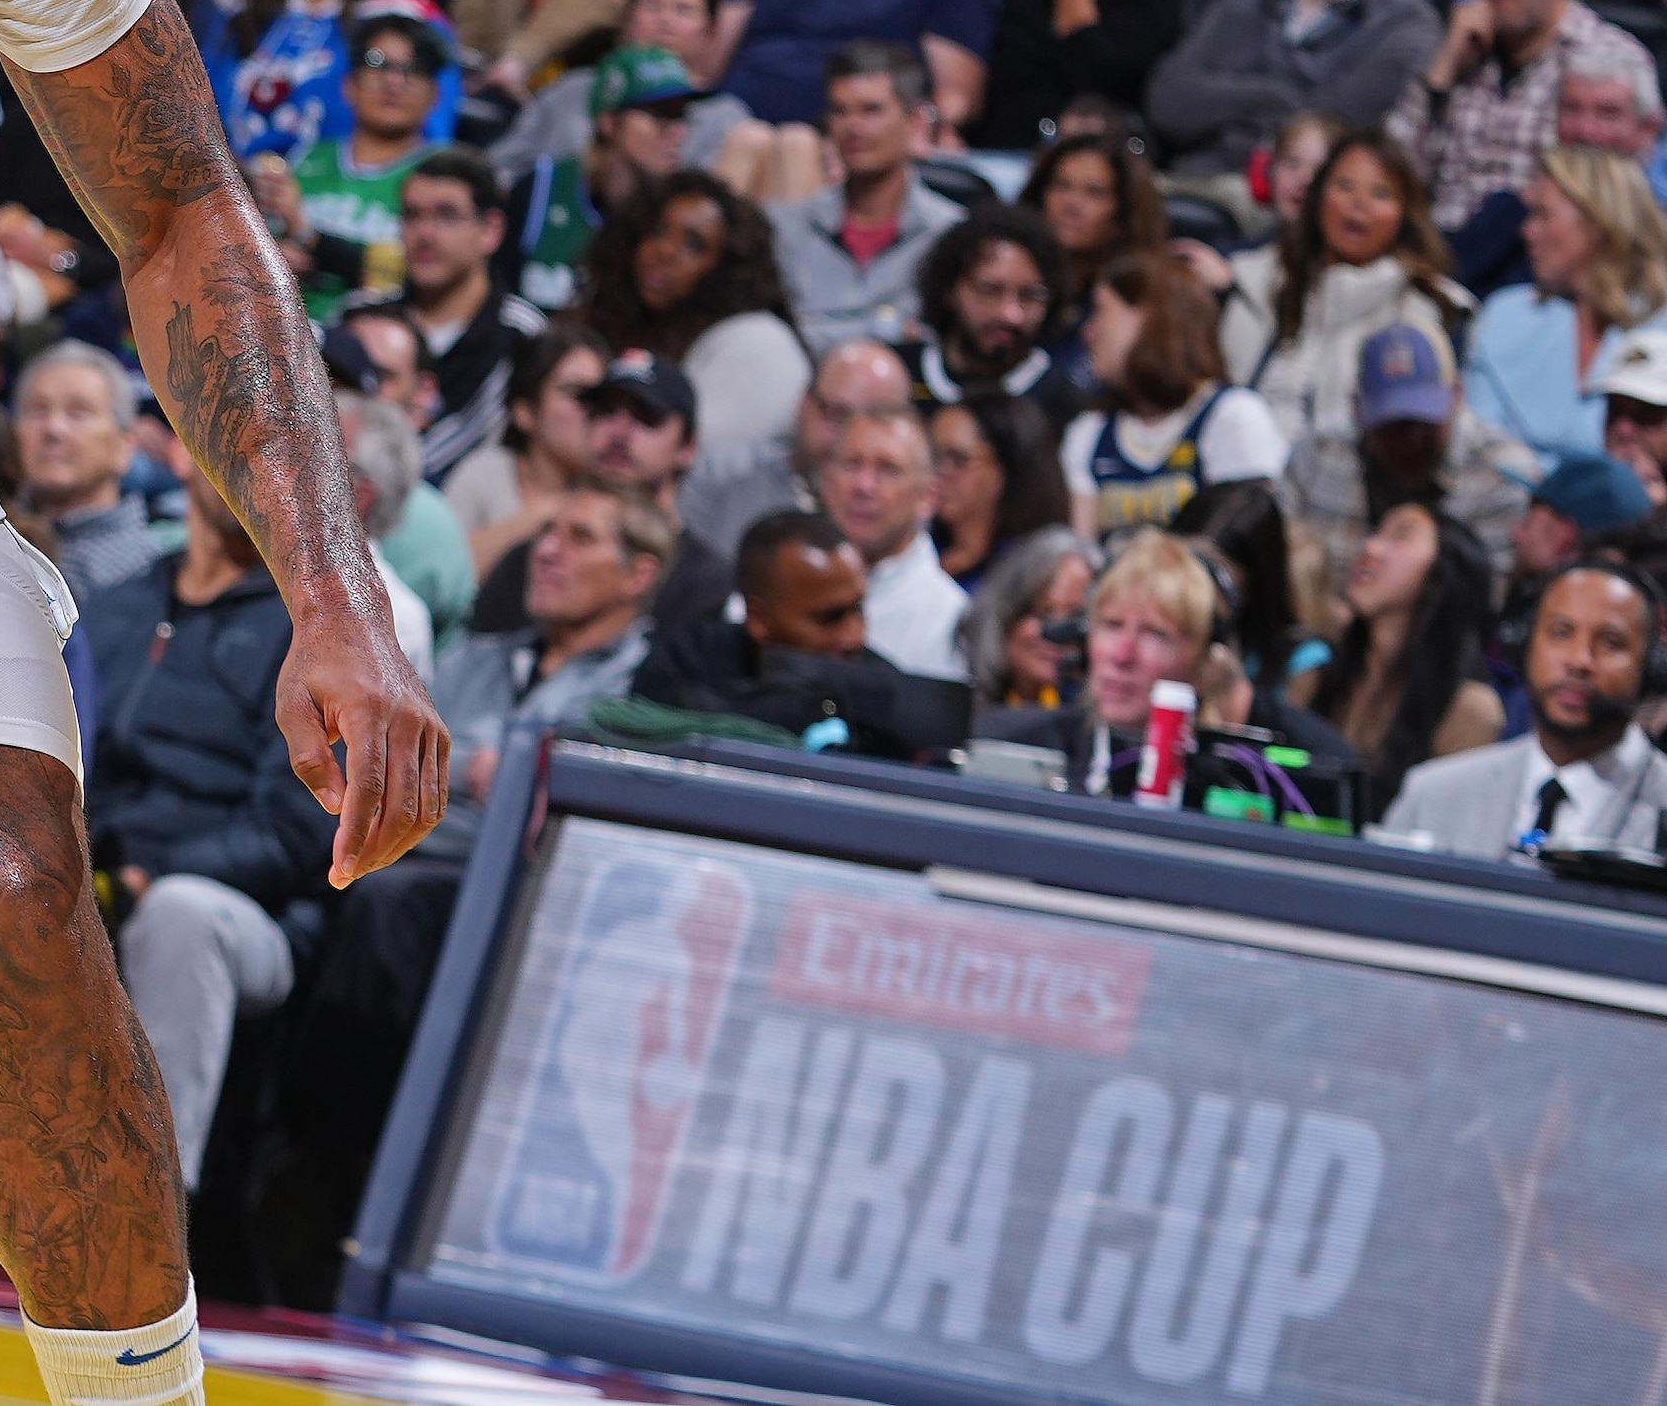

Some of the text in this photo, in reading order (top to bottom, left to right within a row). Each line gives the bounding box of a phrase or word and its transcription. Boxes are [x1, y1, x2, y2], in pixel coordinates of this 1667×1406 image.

[801, 911, 1122, 1027] Emirates
[680, 1016, 1384, 1398] NBA CUP
